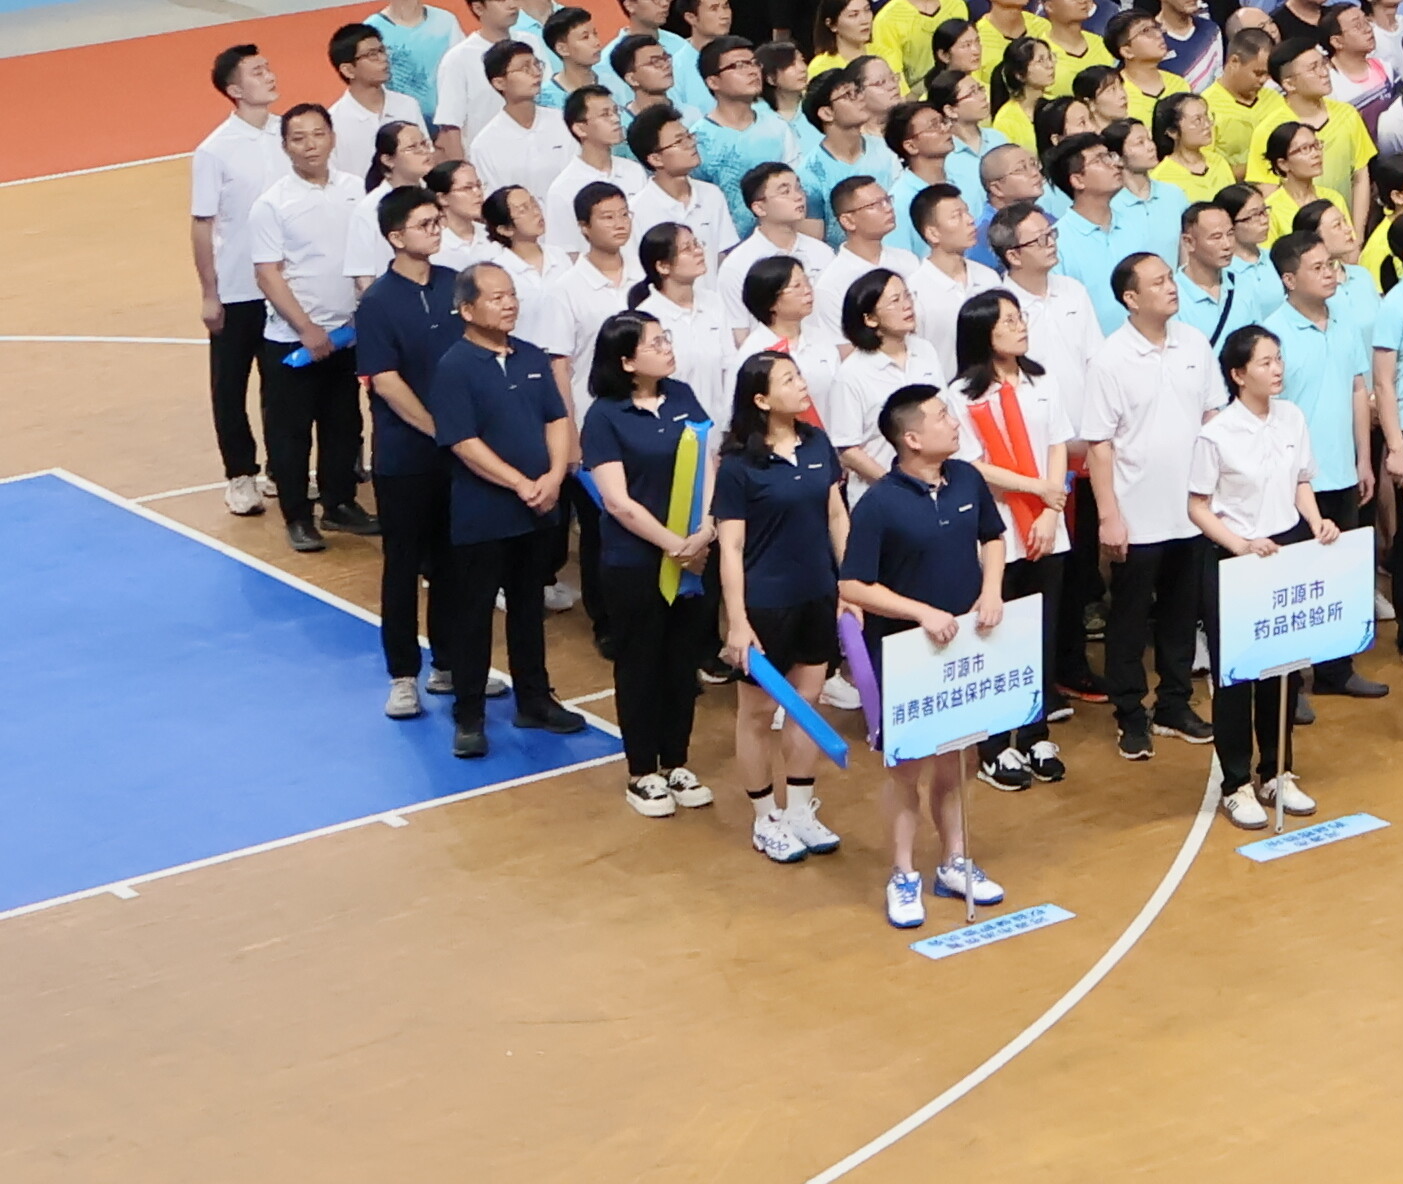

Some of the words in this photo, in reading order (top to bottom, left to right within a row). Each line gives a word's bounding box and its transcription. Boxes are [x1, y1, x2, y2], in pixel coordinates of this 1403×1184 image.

[1271, 579, 1326, 610] 河源市
[1253, 600, 1345, 641] 药品检验所
[943, 652, 985, 684] 河源市
[892, 664, 1035, 727] 消费者权益保护委员会
